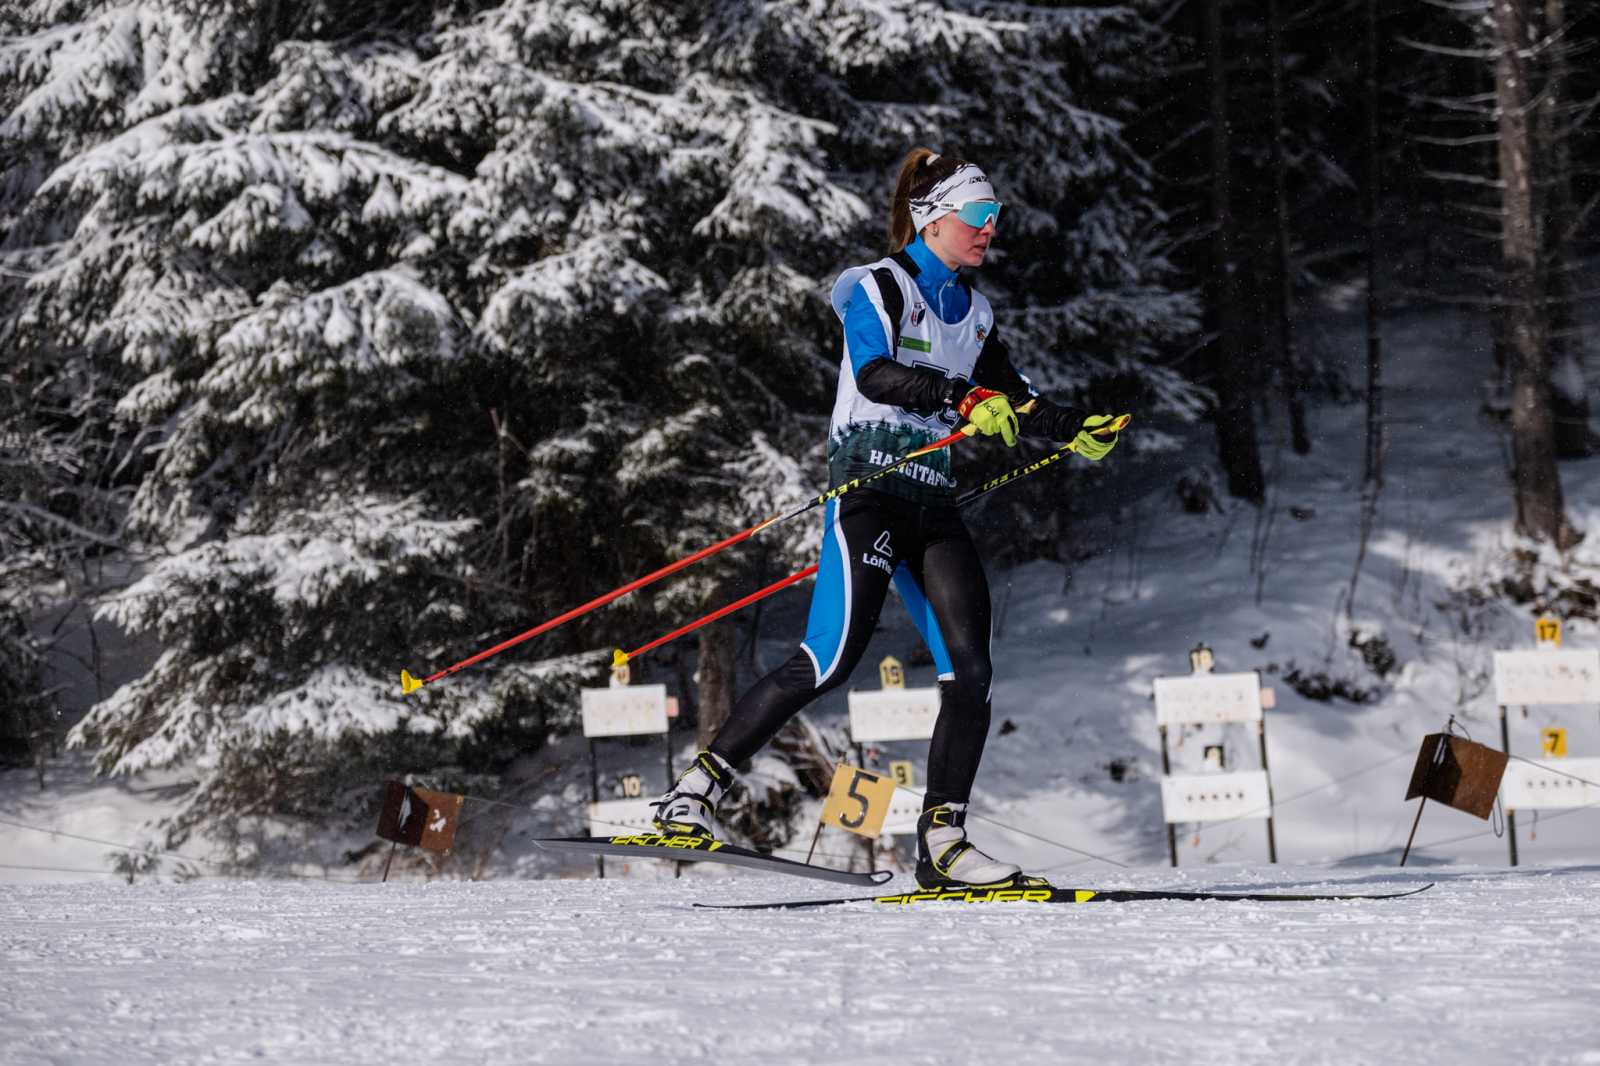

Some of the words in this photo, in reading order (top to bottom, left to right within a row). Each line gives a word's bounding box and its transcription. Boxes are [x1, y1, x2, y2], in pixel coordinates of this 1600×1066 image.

[817, 478, 859, 505] LEKI
[1539, 623, 1557, 641] 17
[1548, 732, 1559, 753] 7
[895, 764, 907, 785] 9
[840, 770, 879, 828] 5
[611, 834, 704, 849] FISCHER
